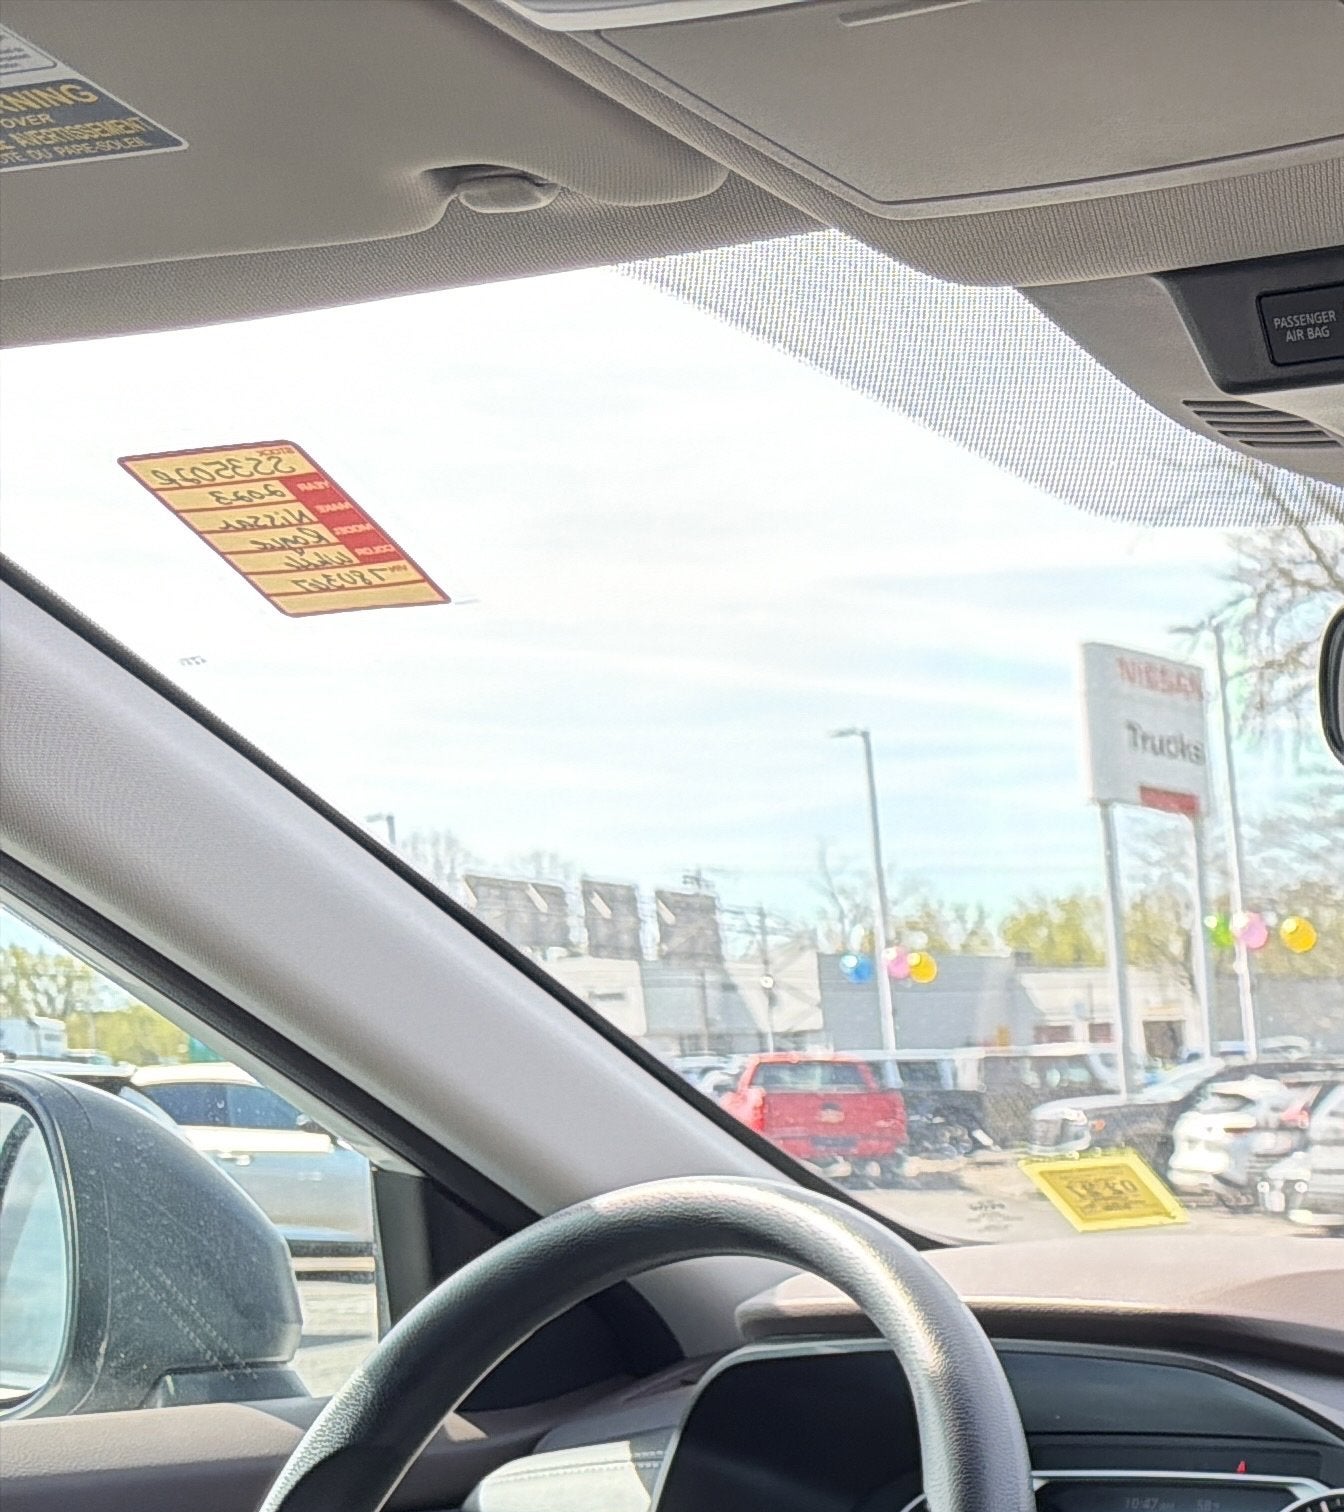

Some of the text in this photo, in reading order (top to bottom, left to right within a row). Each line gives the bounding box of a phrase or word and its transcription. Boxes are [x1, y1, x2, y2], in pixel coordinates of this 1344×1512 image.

[0, 114, 55, 128] OVER
[1273, 310, 1337, 329] PASSENGER
[1286, 326, 1330, 342] AIR BAG
